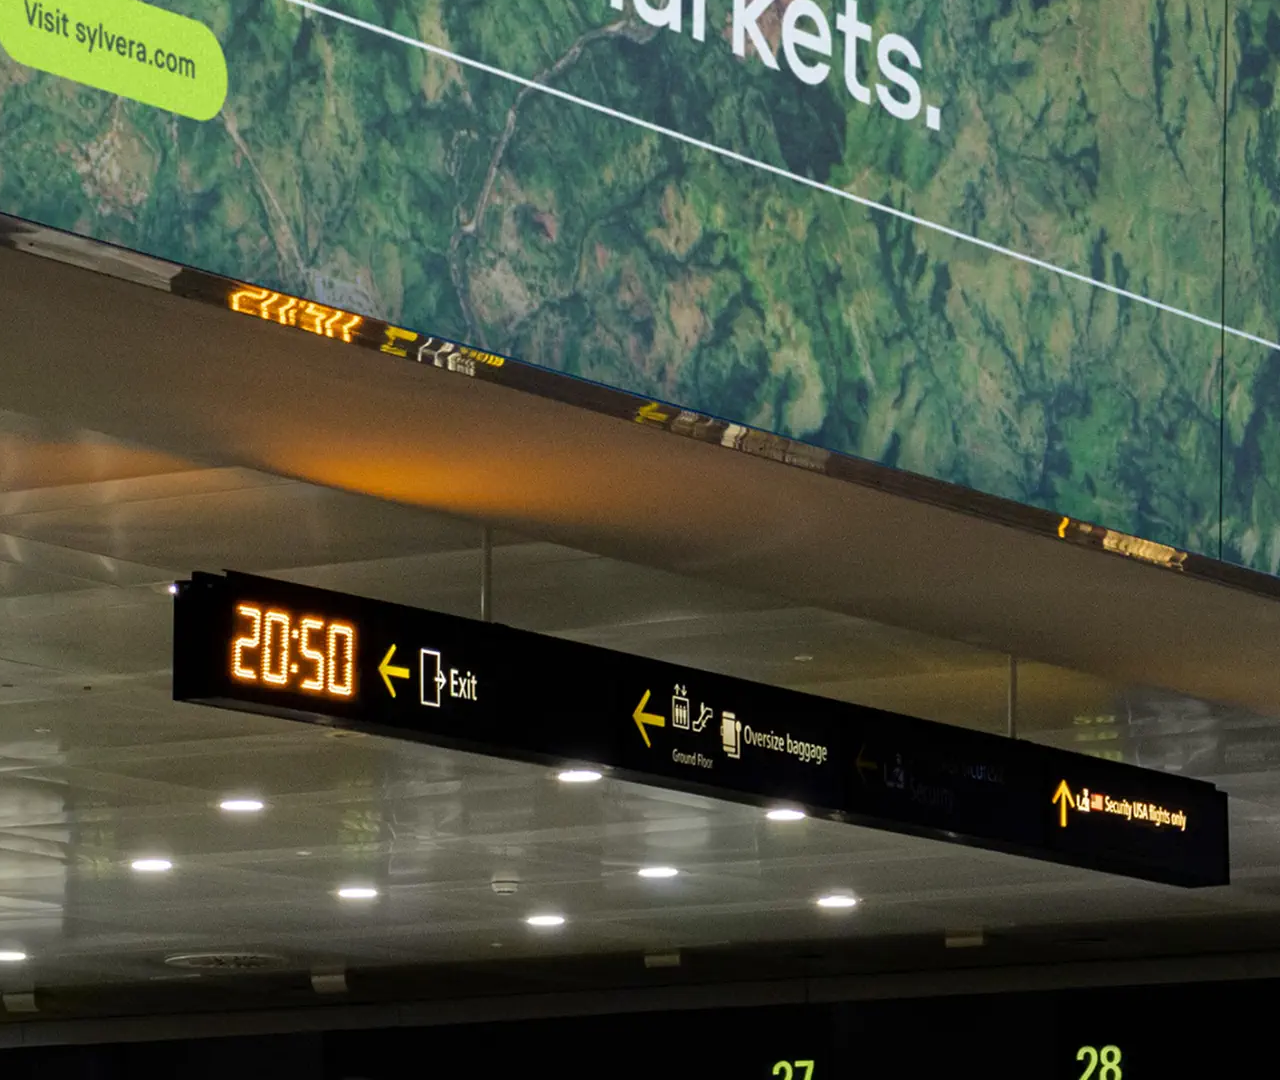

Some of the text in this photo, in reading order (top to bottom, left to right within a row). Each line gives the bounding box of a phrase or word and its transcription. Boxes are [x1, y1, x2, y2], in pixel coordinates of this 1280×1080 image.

[75, 22, 196, 79] sylvera.com
[230, 602, 356, 698] 20:50
[450, 667, 478, 701] Exit
[672, 748, 714, 769] Ground Floor
[743, 725, 828, 765] Oversize baggage
[1104, 795, 1187, 832] Security USA flights only
[1076, 1044, 1123, 1080] 28
